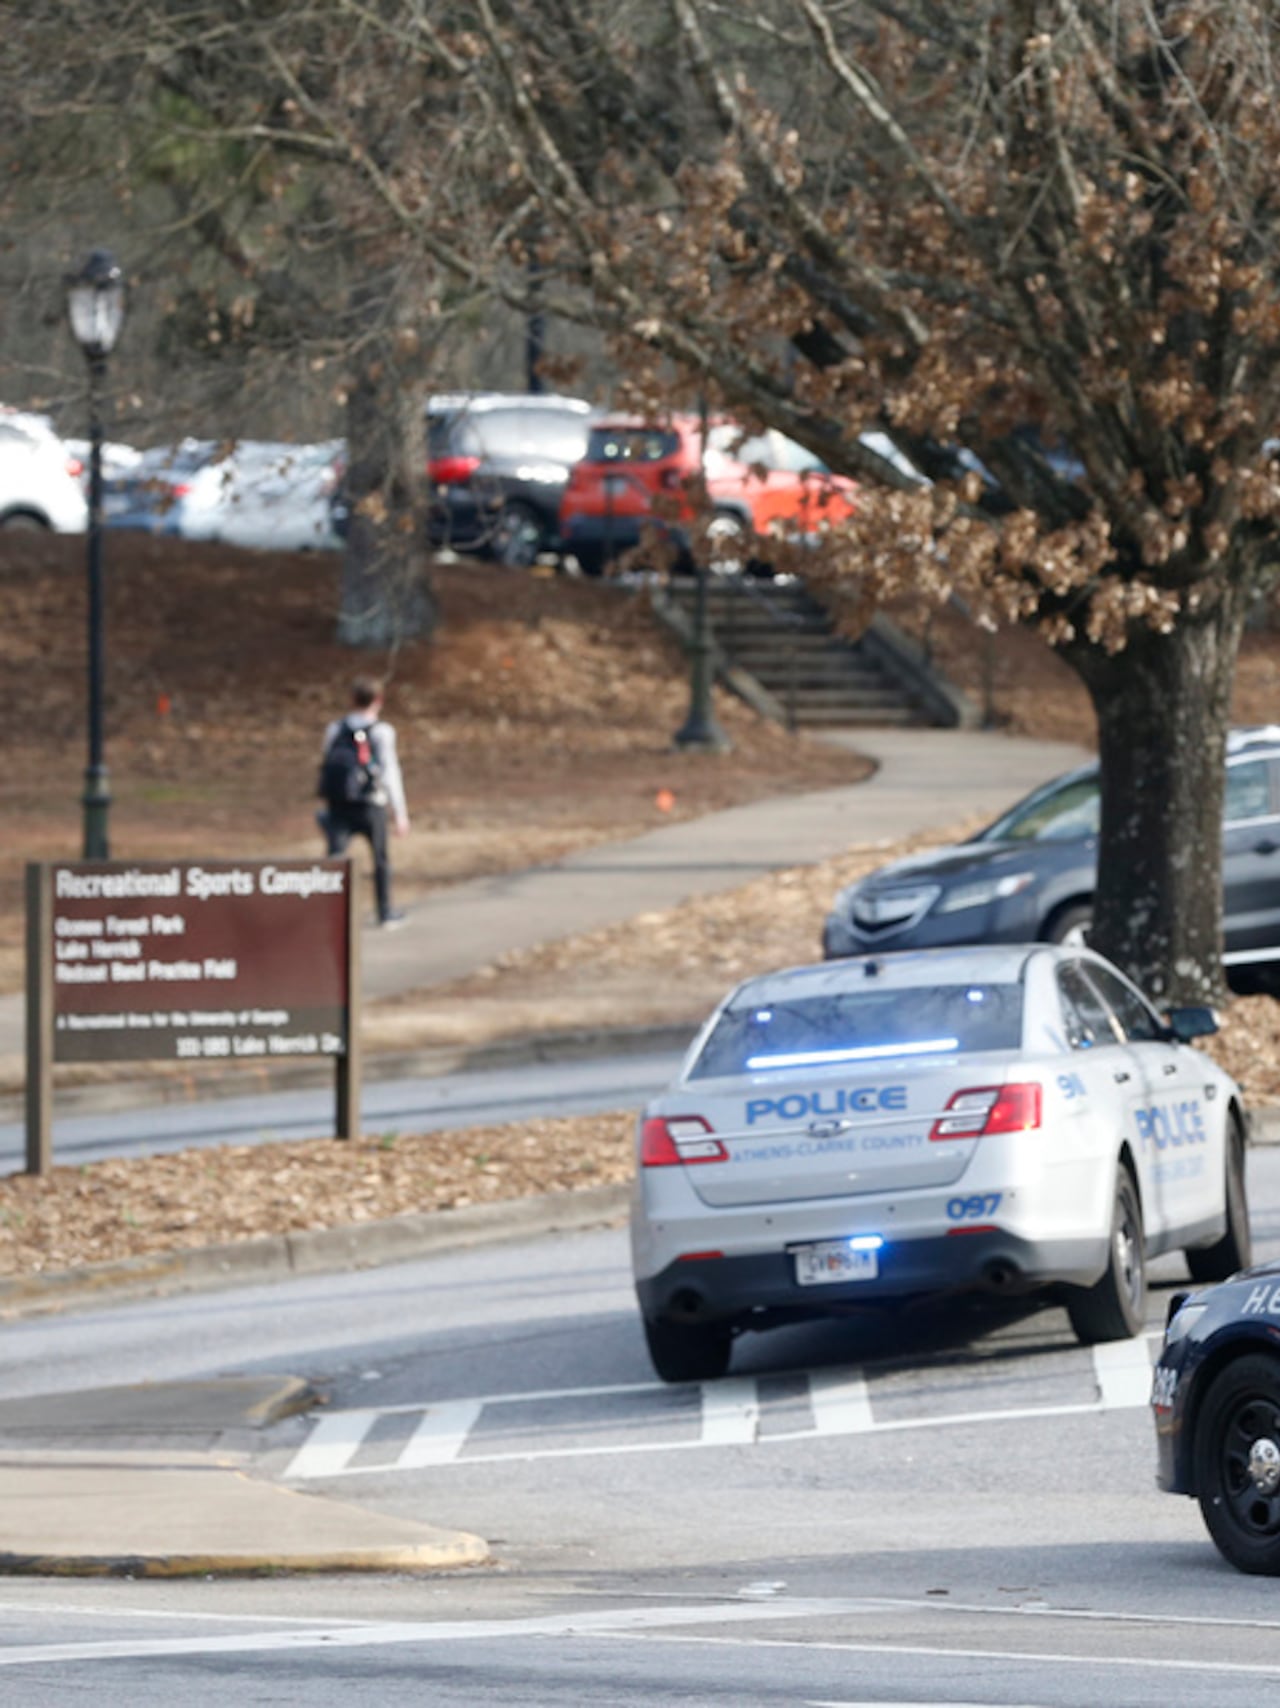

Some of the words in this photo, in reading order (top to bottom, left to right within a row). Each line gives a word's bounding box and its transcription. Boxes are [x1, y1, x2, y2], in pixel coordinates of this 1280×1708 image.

[56, 867, 180, 898] Recreational
[186, 866, 254, 900] Sports
[259, 865, 344, 899] Complex
[56, 939, 89, 960] Lake
[745, 1085, 907, 1125] POLICE
[1134, 1101, 1206, 1152] POLICE
[733, 1136, 855, 1163] ATHENS-CLARKE
[861, 1135, 923, 1151] COUNTY
[946, 1191, 1003, 1220] 097
